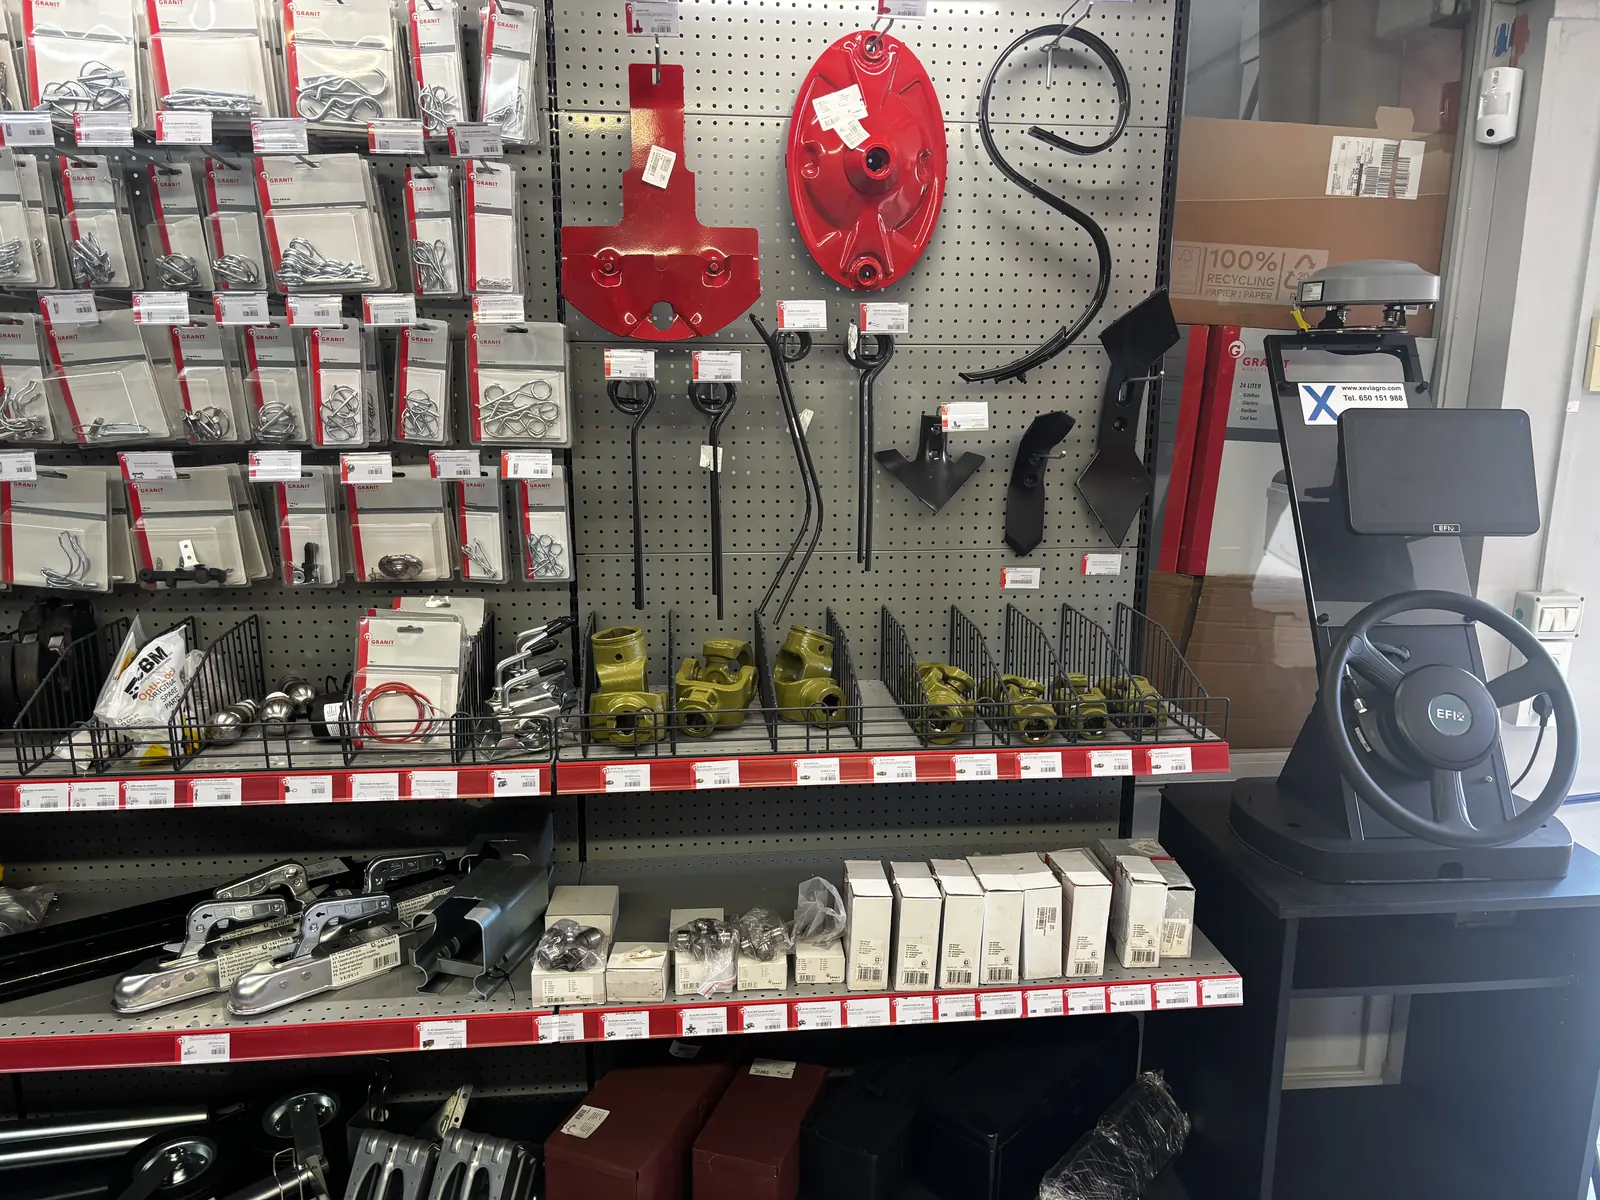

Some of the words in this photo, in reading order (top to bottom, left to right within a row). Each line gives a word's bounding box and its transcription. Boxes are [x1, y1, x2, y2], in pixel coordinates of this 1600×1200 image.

[497, 21, 519, 29] GRANIT
[1210, 249, 1277, 271] 100%
[1207, 273, 1275, 287] RECYCLING
[1206, 289, 1236, 298] PAPIER
[1244, 292, 1272, 300] PAPER
[138, 667, 176, 701] Opti-Lock
[160, 686, 178, 702] SPARE
[164, 693, 181, 710] PARTS
